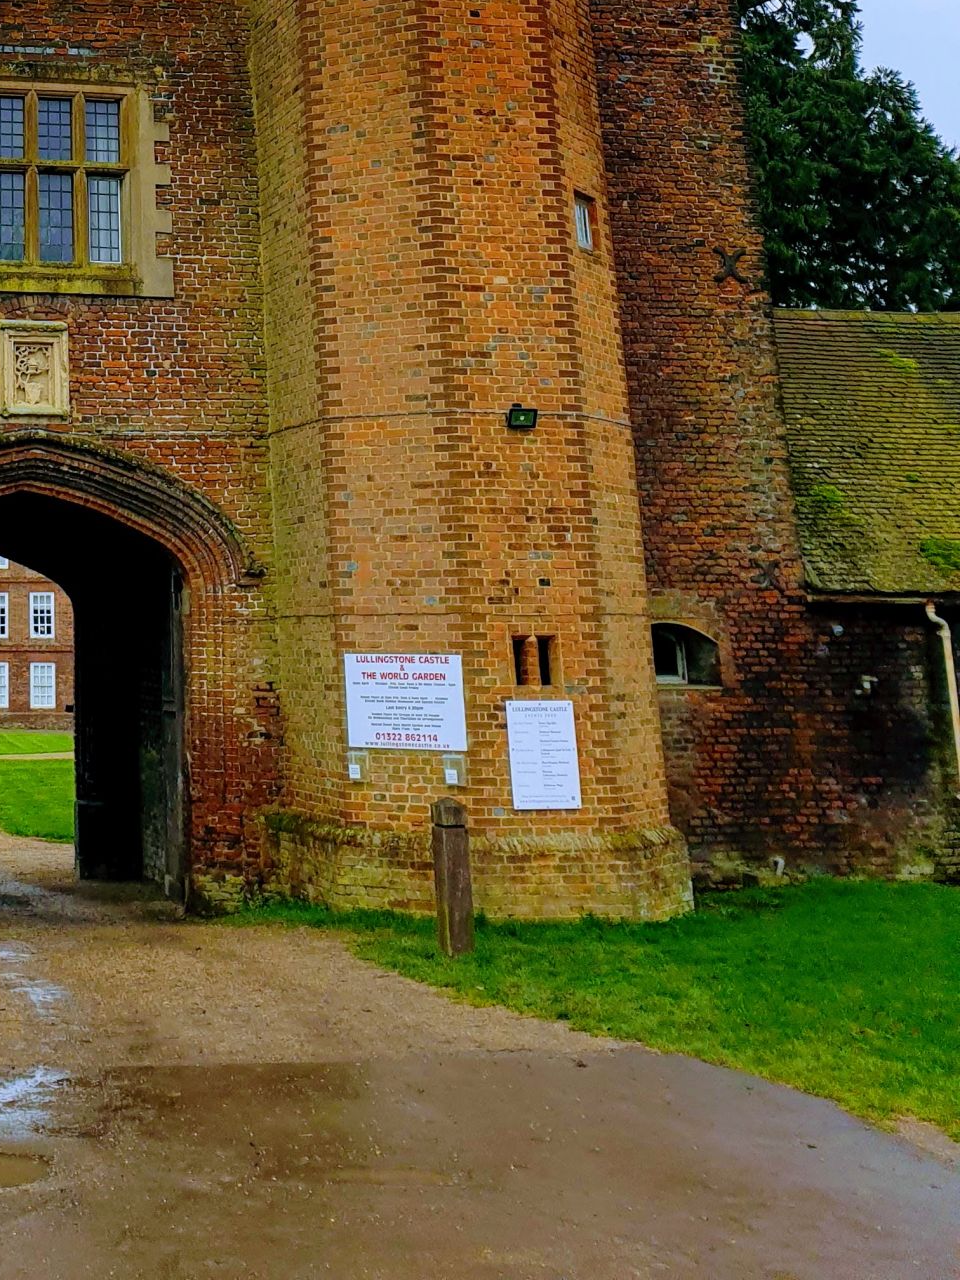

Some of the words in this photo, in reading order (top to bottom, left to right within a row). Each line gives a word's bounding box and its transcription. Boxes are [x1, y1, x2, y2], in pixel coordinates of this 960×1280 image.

[355, 655, 416, 664] LULLINGSTONE
[418, 656, 450, 664] CASTLE
[399, 664, 406, 672] &
[361, 671, 377, 680] THE
[380, 672, 409, 681] WORLD
[412, 672, 447, 681] GARDEN
[375, 732, 402, 741] 01322
[405, 733, 438, 742] 862114
